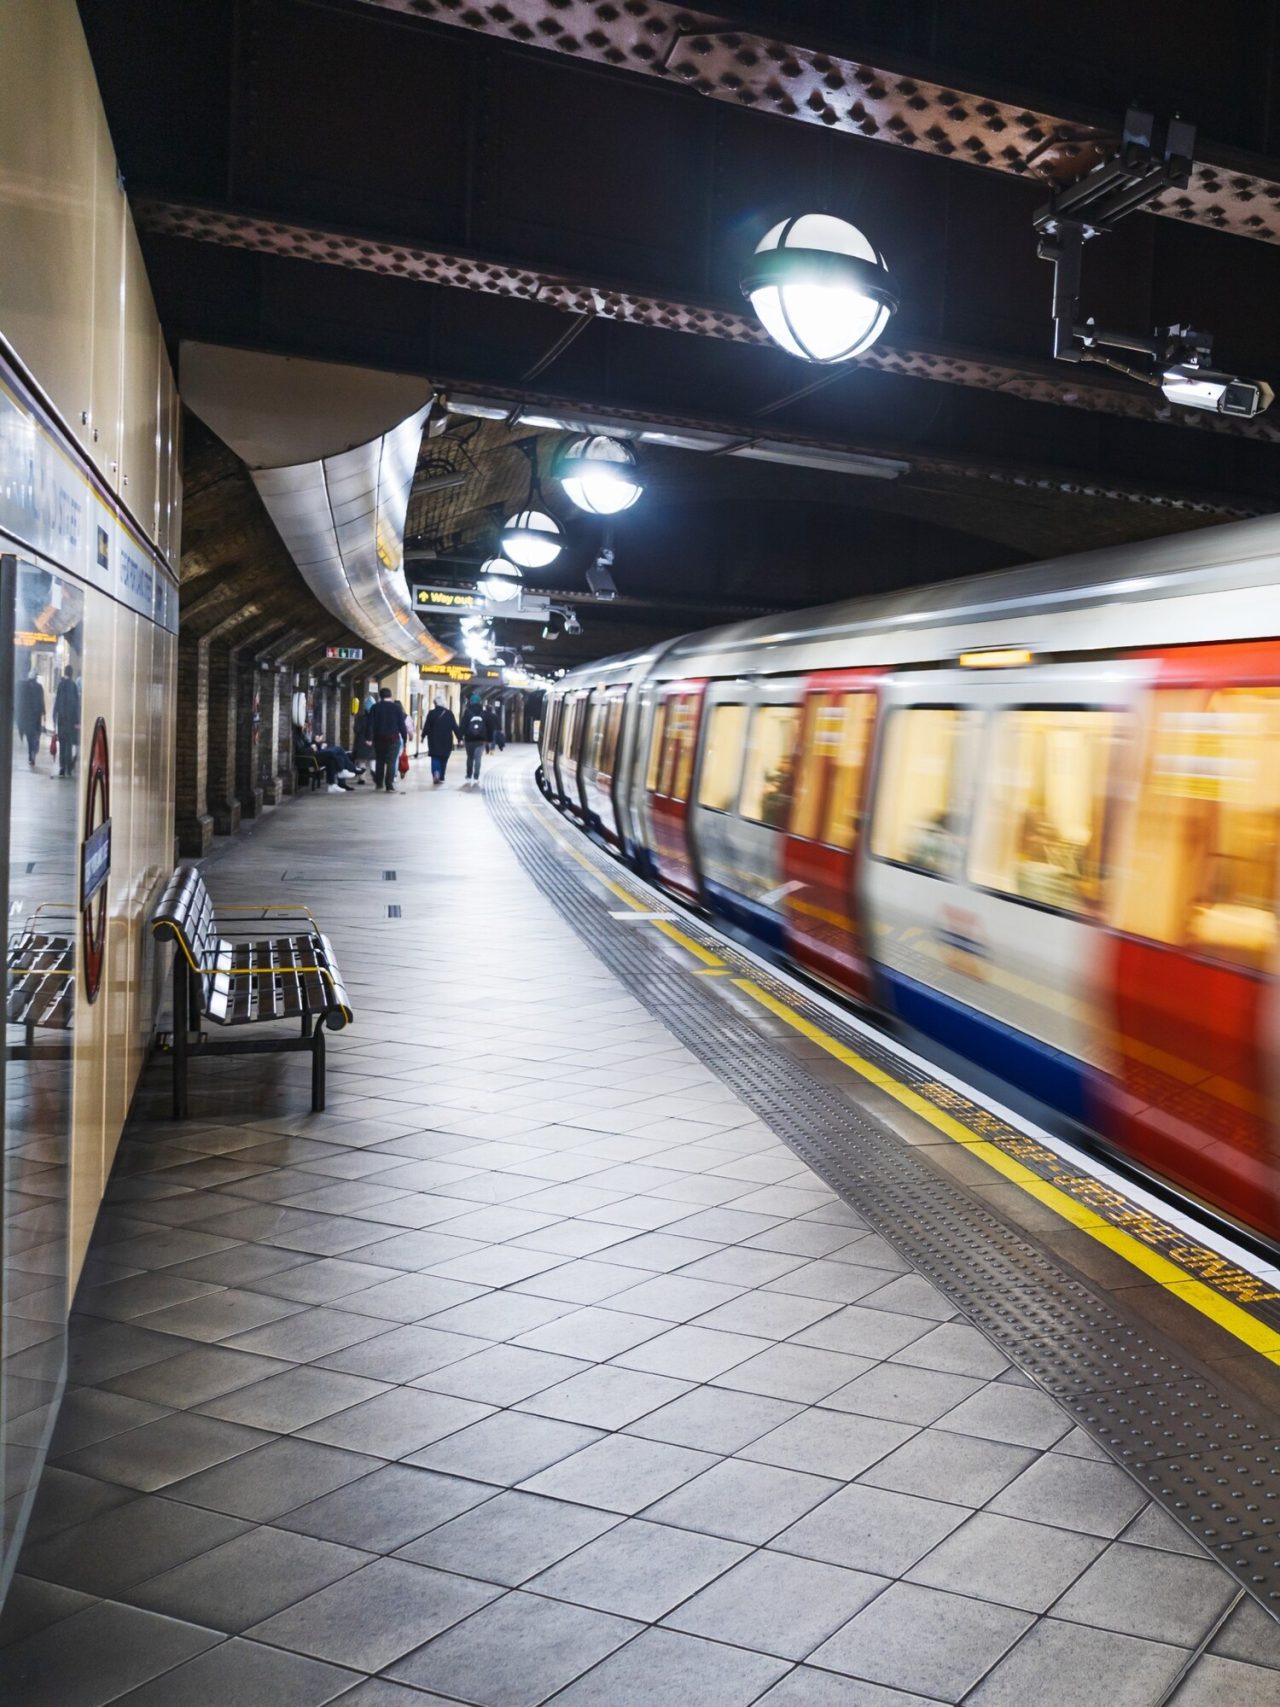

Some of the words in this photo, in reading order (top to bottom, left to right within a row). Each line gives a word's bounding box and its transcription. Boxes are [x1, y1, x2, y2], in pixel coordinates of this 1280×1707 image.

[430, 592, 454, 605] Way
[454, 595, 474, 606] out
[993, 1135, 1058, 1162] GAP
[1053, 1174, 1127, 1207] GAP
[1106, 1208, 1186, 1244] THE
